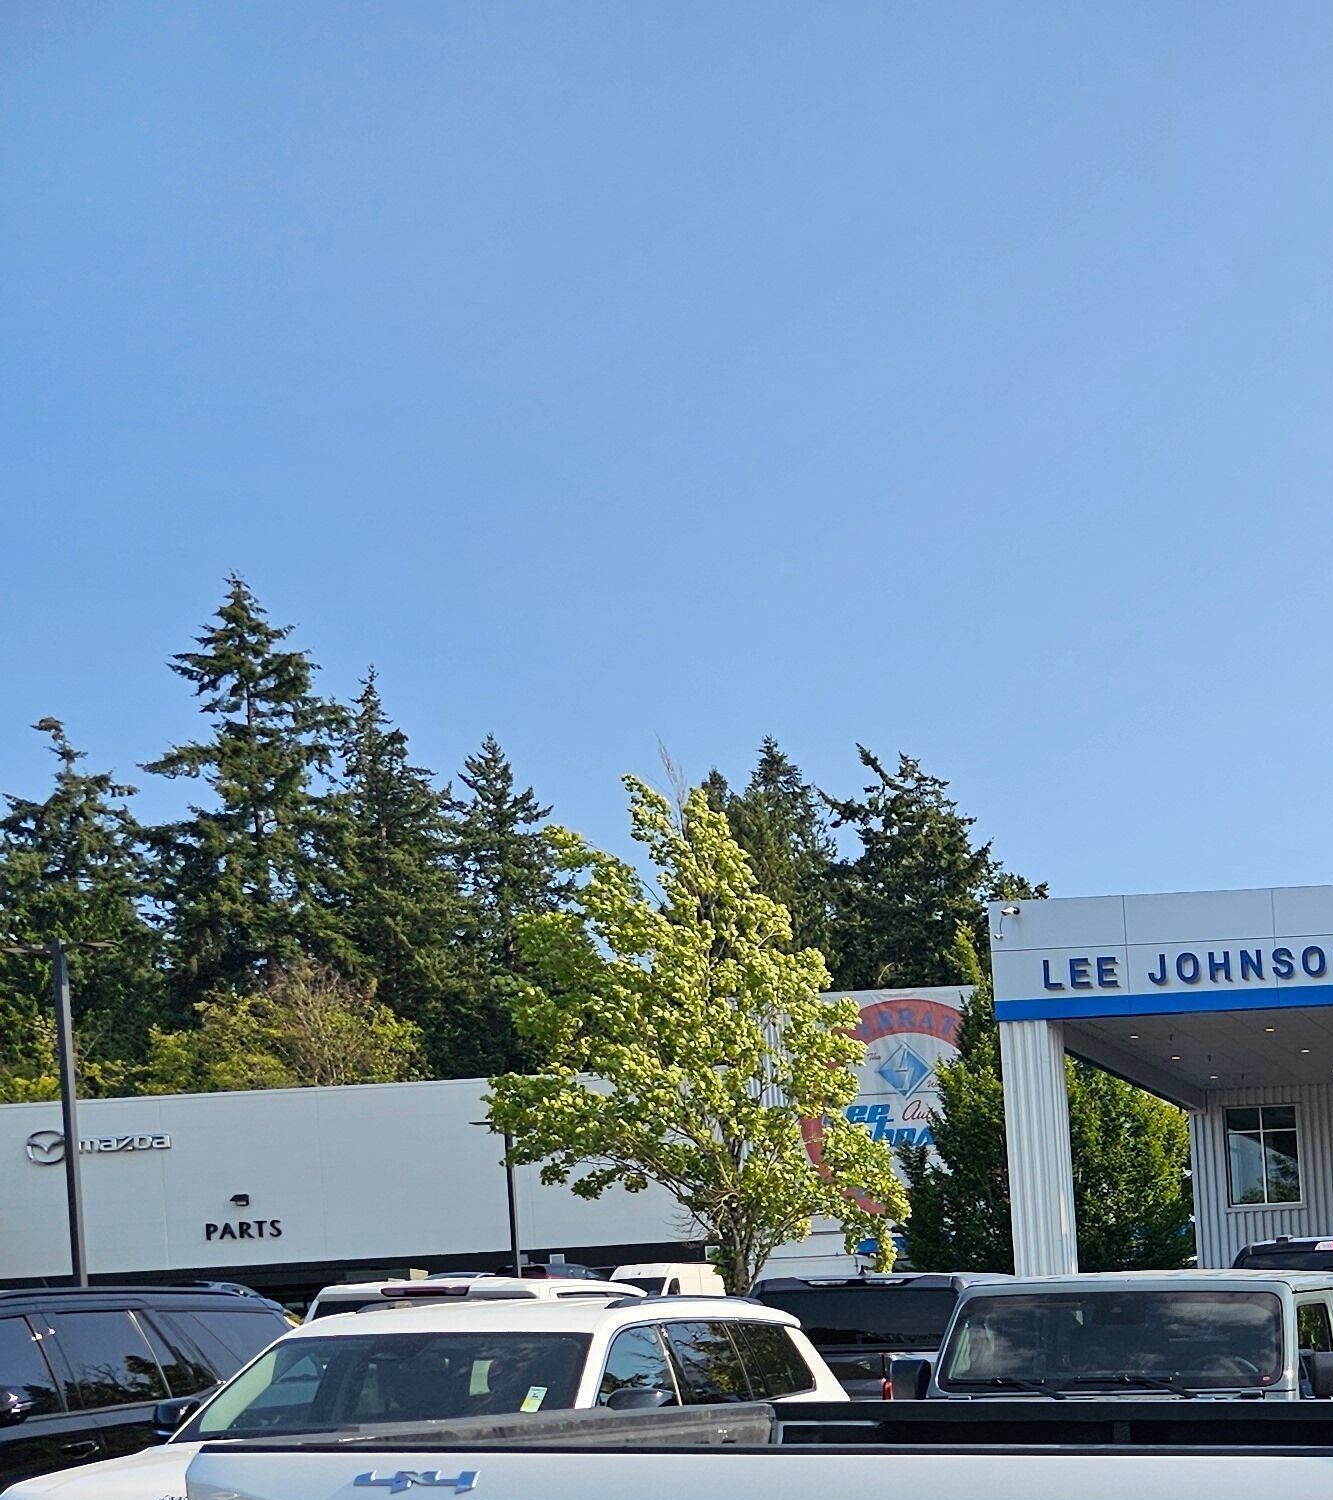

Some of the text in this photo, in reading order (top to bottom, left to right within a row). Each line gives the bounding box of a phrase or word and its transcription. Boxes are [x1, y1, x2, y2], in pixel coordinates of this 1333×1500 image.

[1042, 956, 1120, 989] LEE
[822, 1104, 890, 1124] ee
[78, 1133, 172, 1153] mazda
[205, 1219, 282, 1240] PARTS
